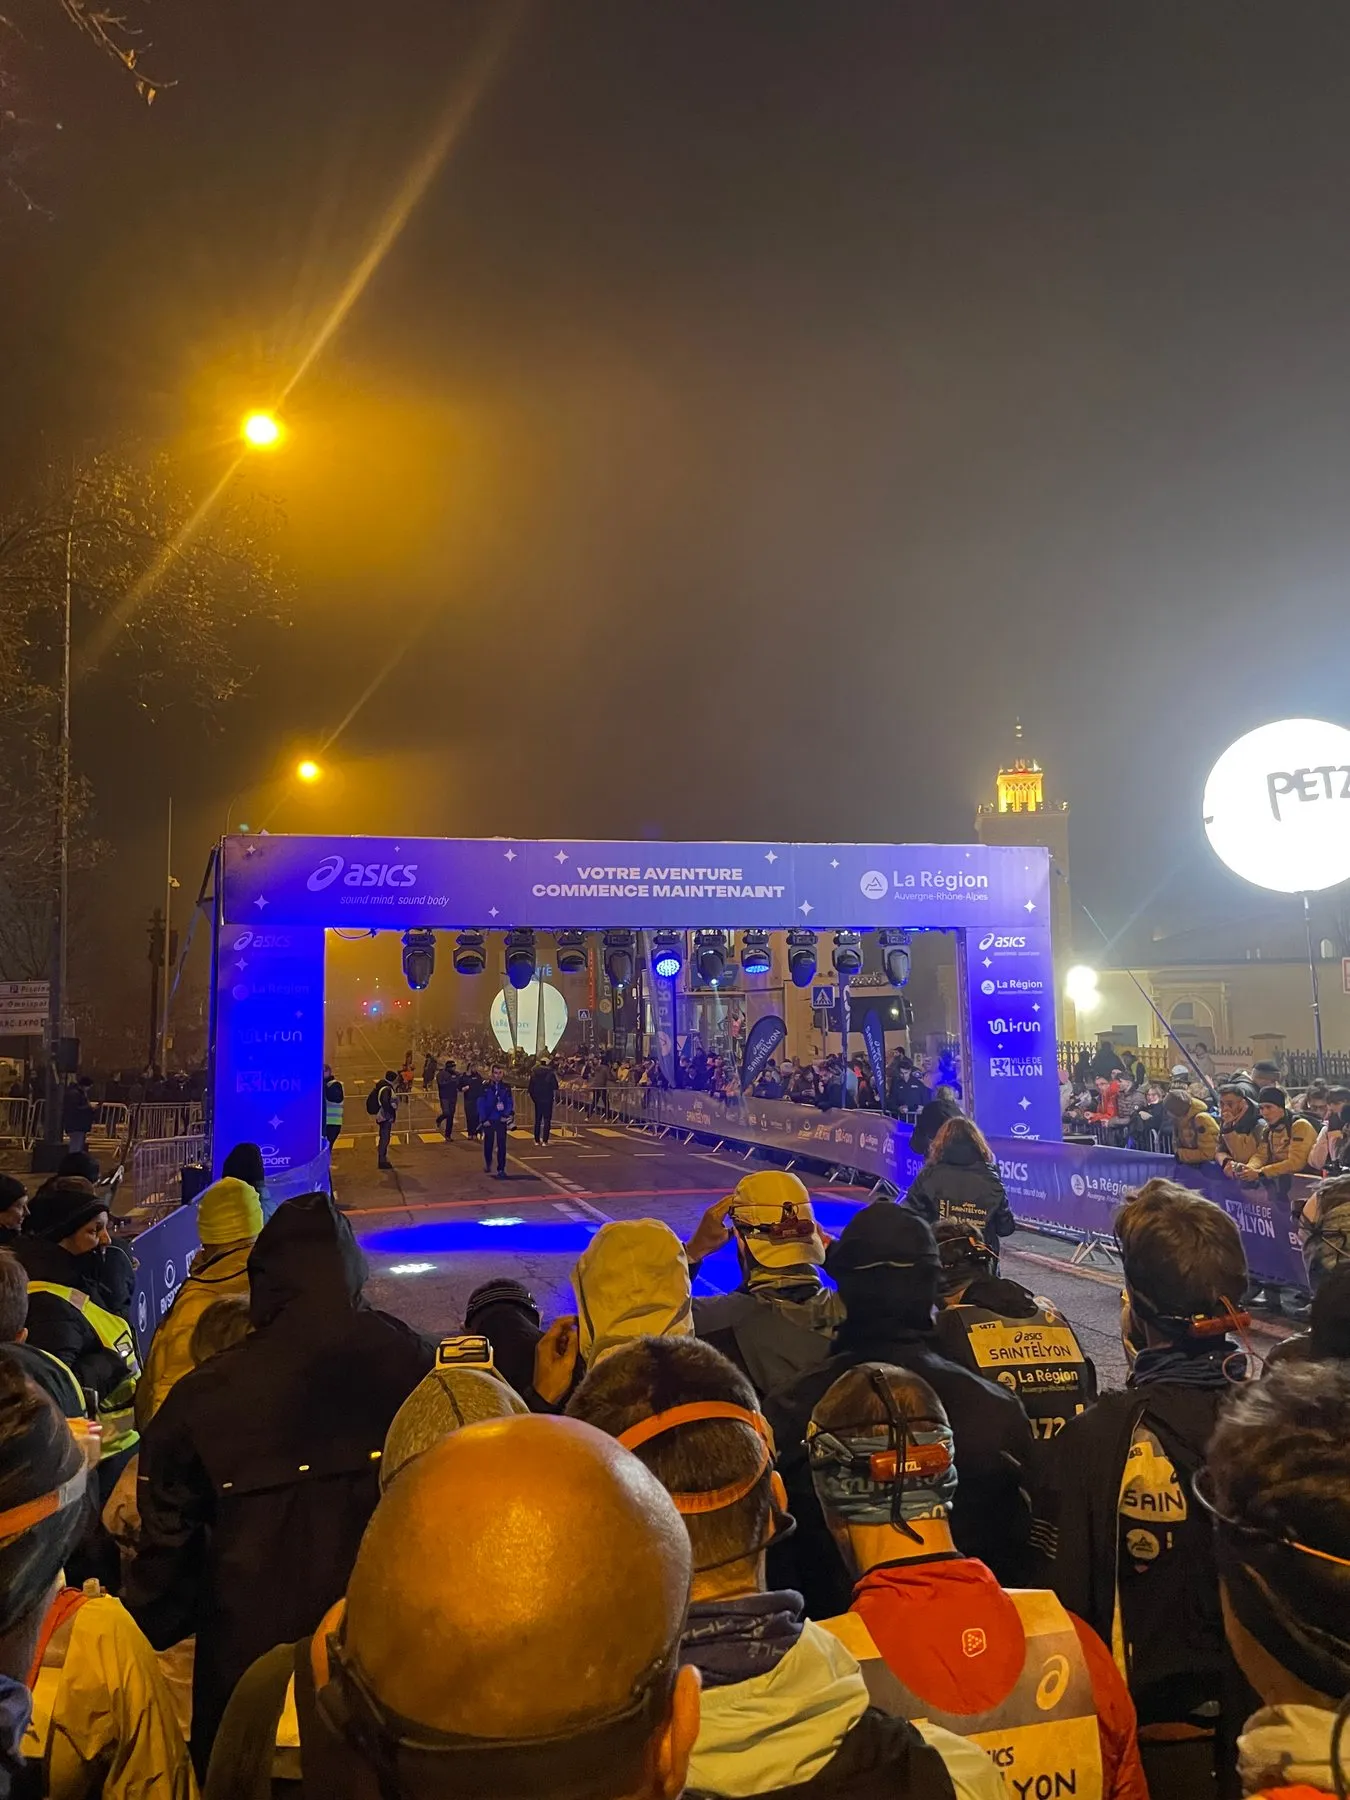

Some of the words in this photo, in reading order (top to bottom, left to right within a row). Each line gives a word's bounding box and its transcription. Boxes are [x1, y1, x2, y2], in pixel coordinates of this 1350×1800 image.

[343, 863, 418, 887] asics
[576, 867, 641, 880] VOTRE
[643, 867, 743, 881] AVENTURE
[893, 870, 916, 887] La
[920, 870, 989, 891] Région
[531, 884, 649, 897] COMMENCE
[652, 885, 786, 898] MAINTENANT
[894, 891, 989, 902] Auvergne-Rhône-Alpes
[340, 895, 369, 905] sound
[370, 895, 395, 906] mind,
[397, 895, 426, 905] sound
[427, 896, 450, 907] body
[994, 936, 1026, 948] asics
[996, 979, 1008, 989] La
[1009, 979, 1043, 991] Région
[1009, 1018, 1041, 1033] i-run
[1010, 1057, 1031, 1065] VILLE
[1010, 1064, 1043, 1077] LYON
[262, 1079, 302, 1092] LYON
[1086, 1175, 1099, 1190] La
[1242, 1202, 1261, 1217] VILLE
[1261, 1207, 1272, 1219] DE
[1244, 1215, 1276, 1239] LYON
[1023, 1332, 1044, 1342] asics
[989, 1341, 1072, 1360] SAINTÉLYON
[1017, 1370, 1034, 1384] La
[1035, 1367, 1079, 1385] Région
[1011, 1767, 1076, 1800] YON
